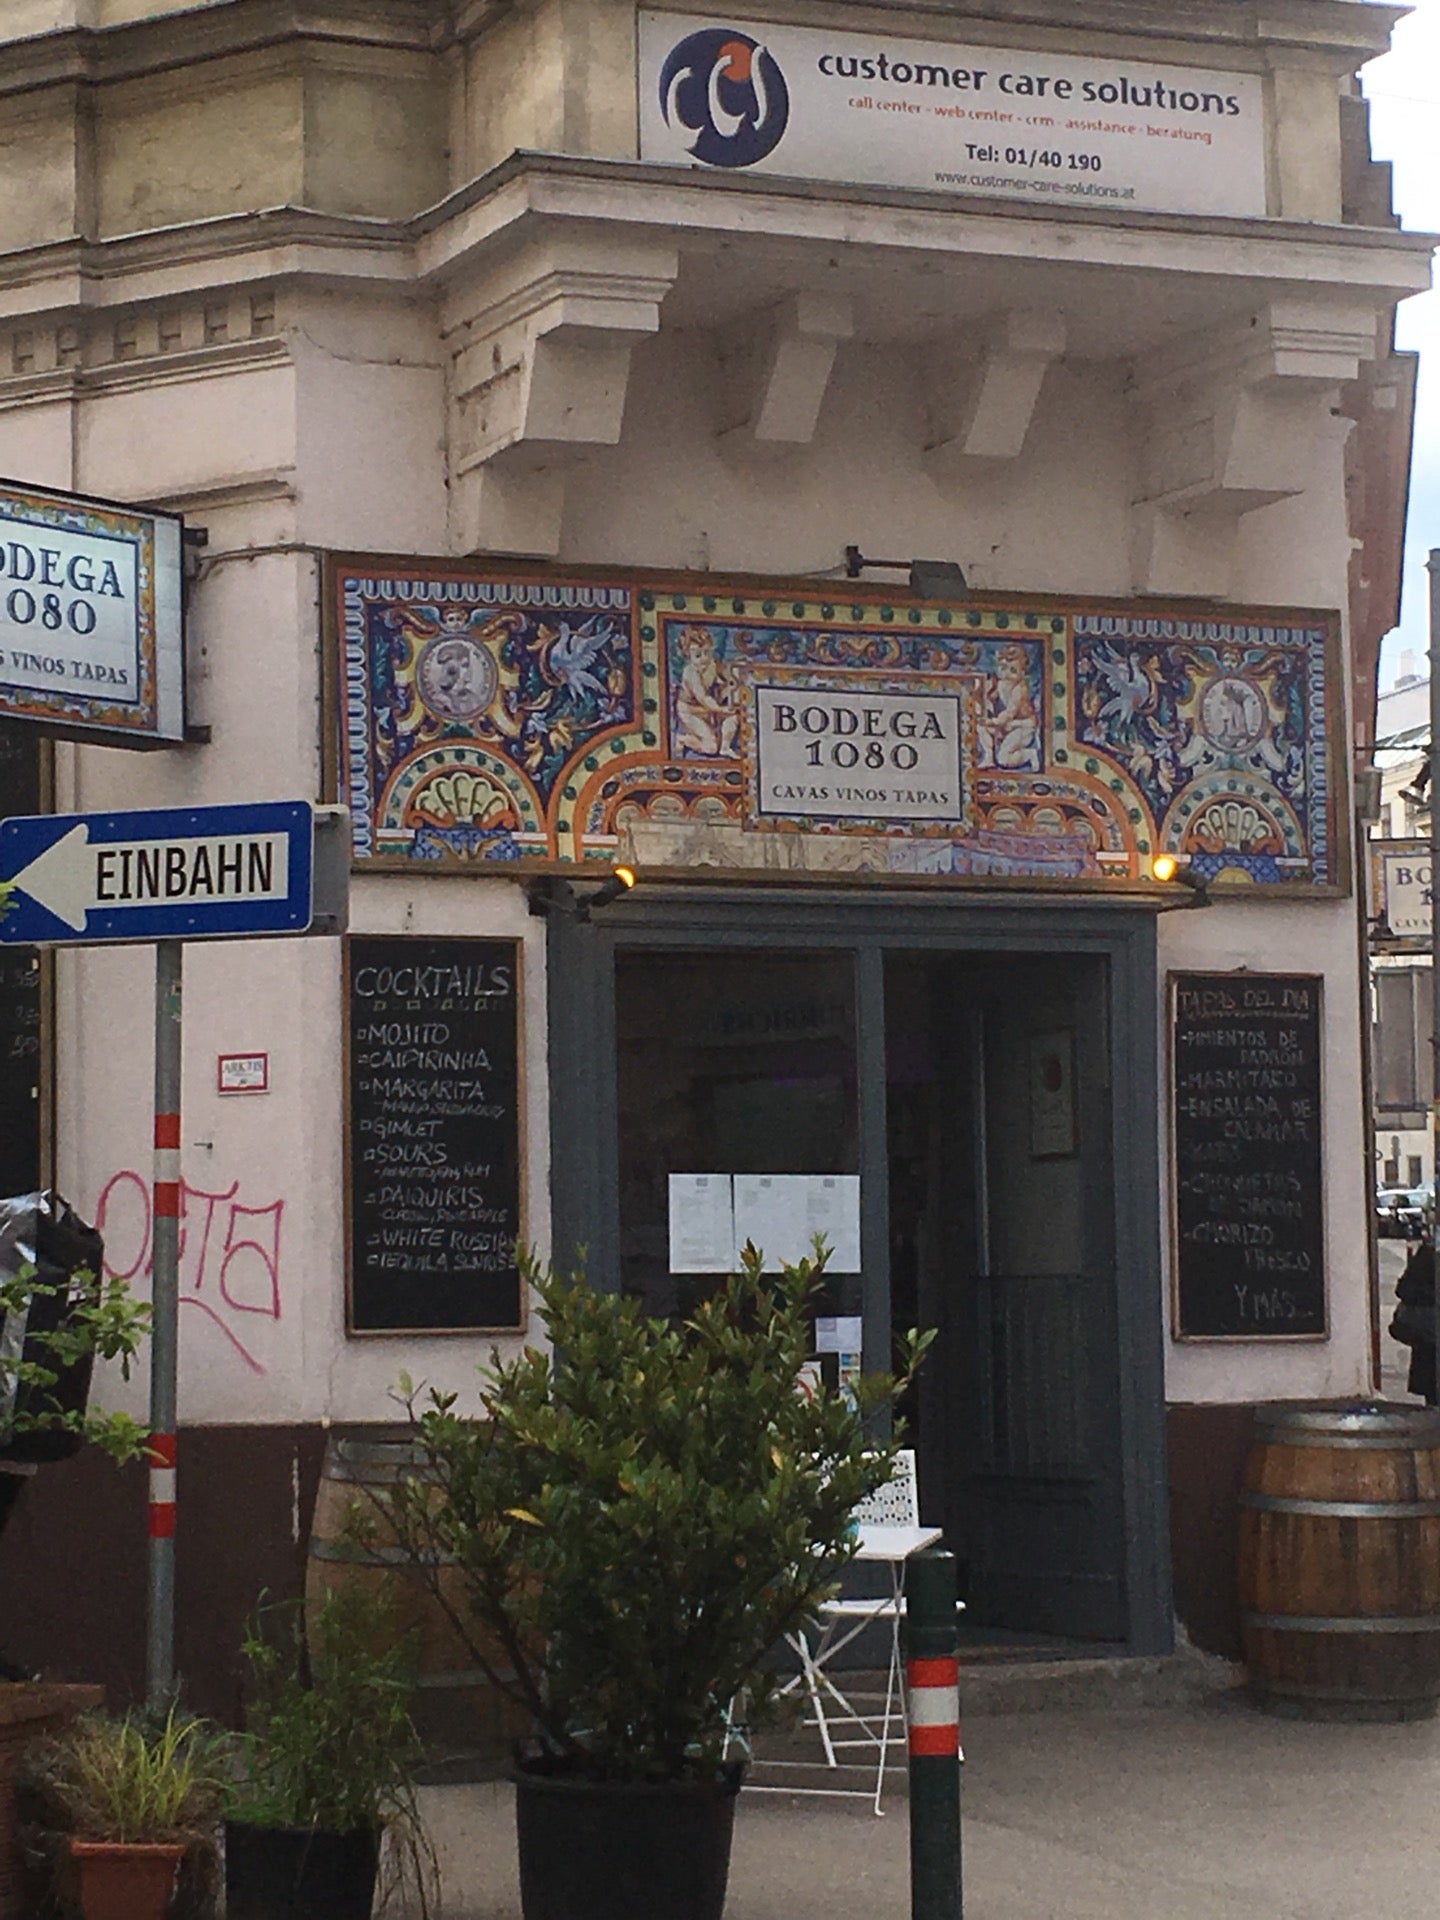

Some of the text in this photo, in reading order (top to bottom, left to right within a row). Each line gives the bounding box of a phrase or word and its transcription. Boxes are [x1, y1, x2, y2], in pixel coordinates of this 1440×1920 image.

[818, 53, 1240, 117] customer care solutions
[848, 96, 1213, 145] call center web center crm assistance beratung
[964, 143, 1102, 172] Tel: 01/40 190
[0, 541, 125, 599] DEGA
[11, 651, 66, 676] VINOS
[71, 661, 128, 685] TAPAS
[772, 704, 947, 740] BODEGA
[804, 739, 919, 770] 1080
[772, 784, 950, 805] CAVAS VINOS TAPAS
[97, 841, 272, 901] EINBAHN
[354, 964, 512, 998] COCKTAILS
[367, 1022, 450, 1046] MOJITO
[369, 1048, 492, 1072] CAIPIRINHA
[372, 1077, 484, 1101] MARGARITA
[373, 1117, 444, 1140] GIMLET
[375, 1143, 449, 1166] SOURS
[378, 1184, 484, 1209] DAIQUIRIS
[381, 1227, 446, 1247] WHITE
